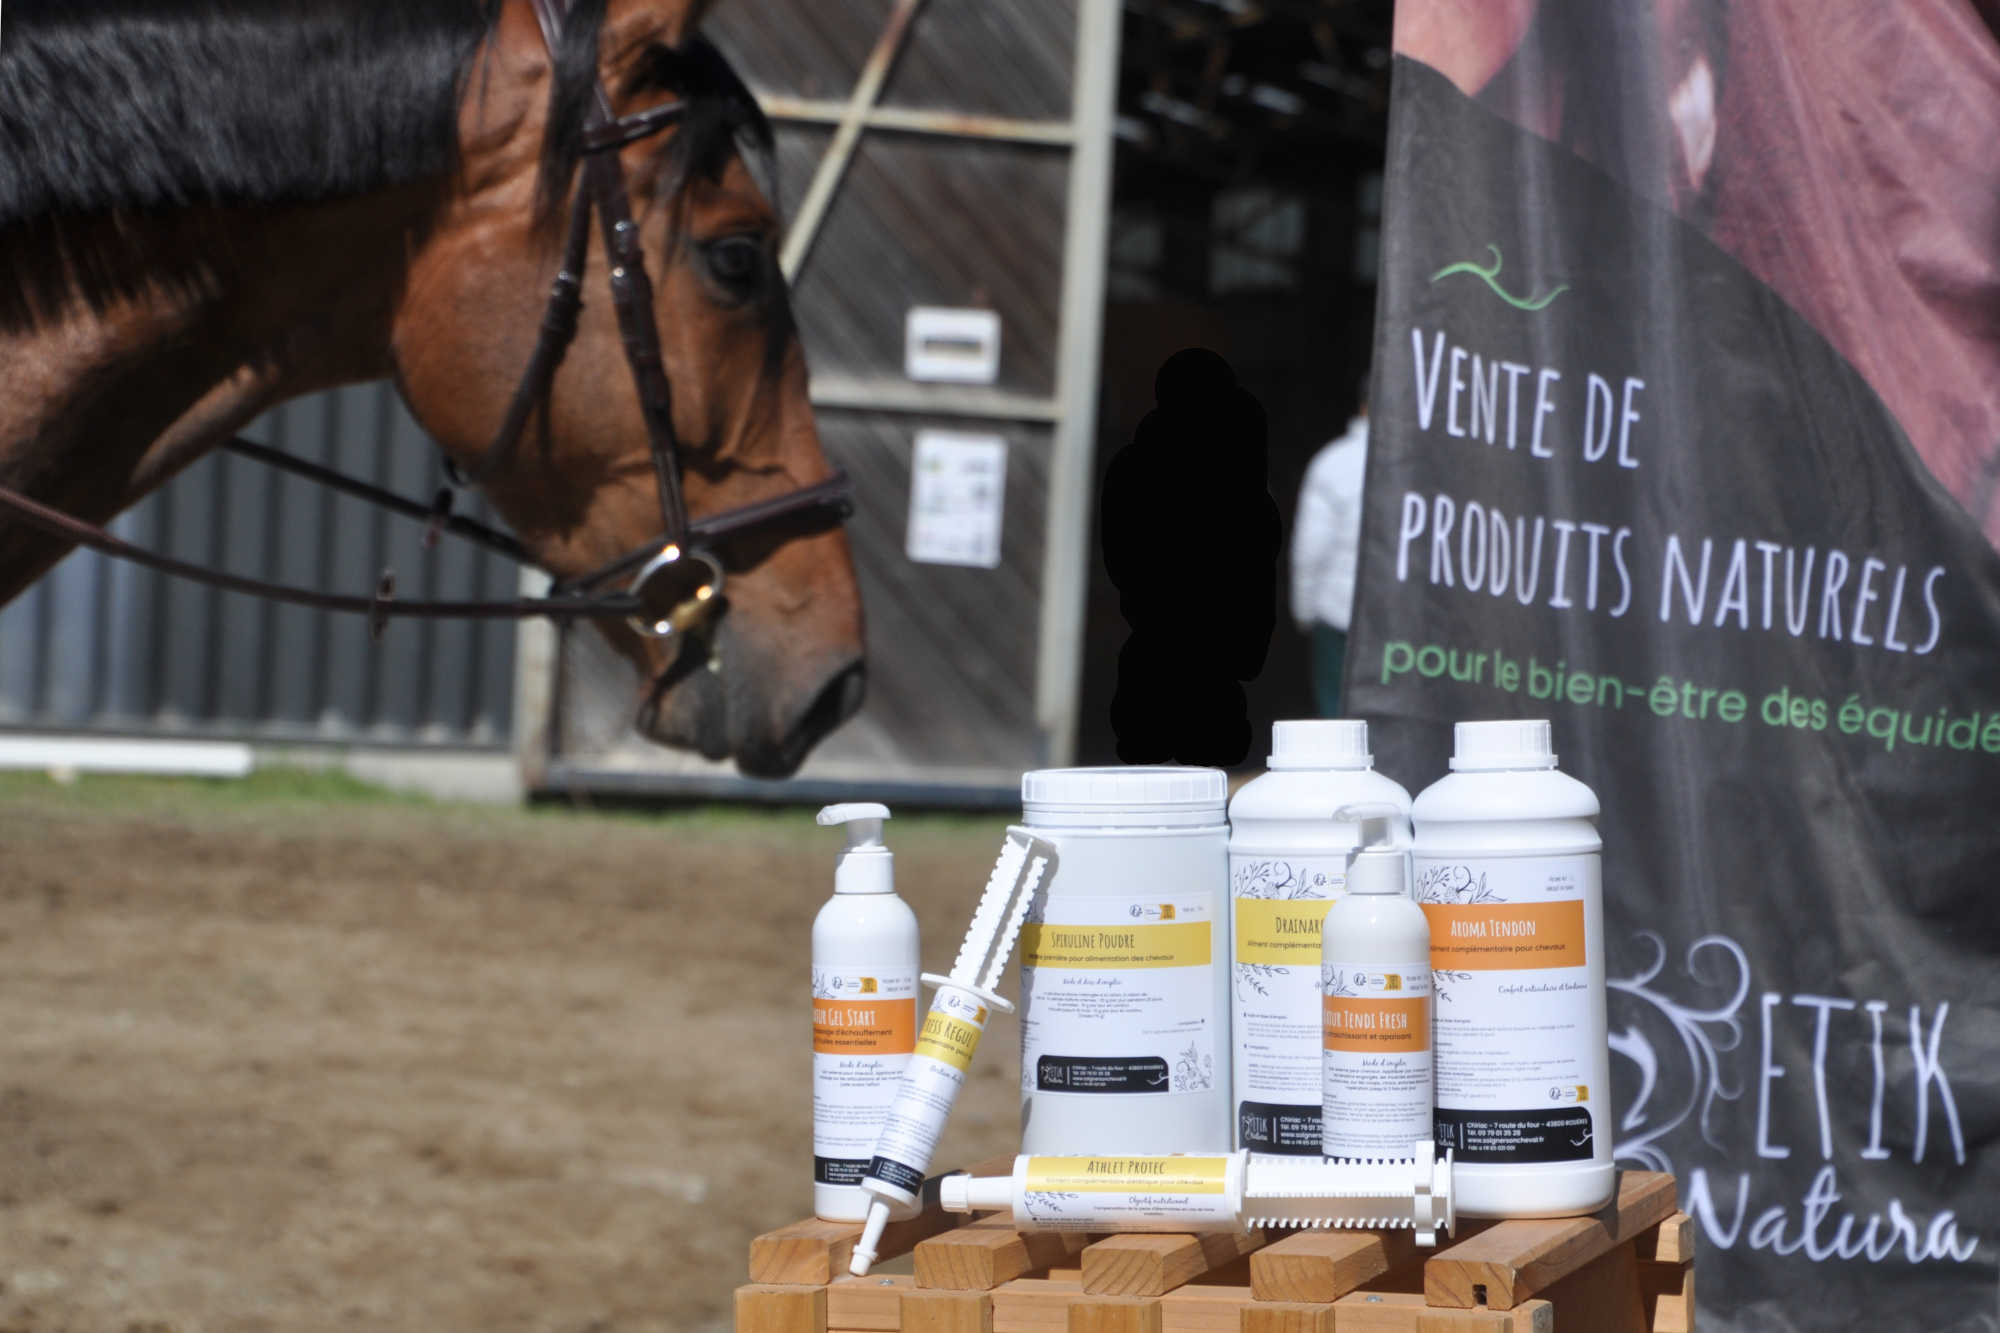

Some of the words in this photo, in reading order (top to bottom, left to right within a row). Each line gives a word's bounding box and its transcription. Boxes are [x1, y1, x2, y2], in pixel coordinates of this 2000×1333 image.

[1411, 327, 1560, 459] VENTE
[1582, 372, 1646, 469] DE
[1397, 492, 1633, 618] PRODUITS
[1660, 535, 1945, 655] NATURELS
[1381, 640, 1488, 685] pour
[1494, 651, 1521, 692] le
[1528, 658, 1748, 724] bien-être
[1761, 687, 1828, 732] des
[1838, 693, 2000, 754] équidé
[1514, 944, 1534, 955] pour
[1757, 992, 1966, 1166] ETIK
[1685, 1165, 1979, 1264] Natura
